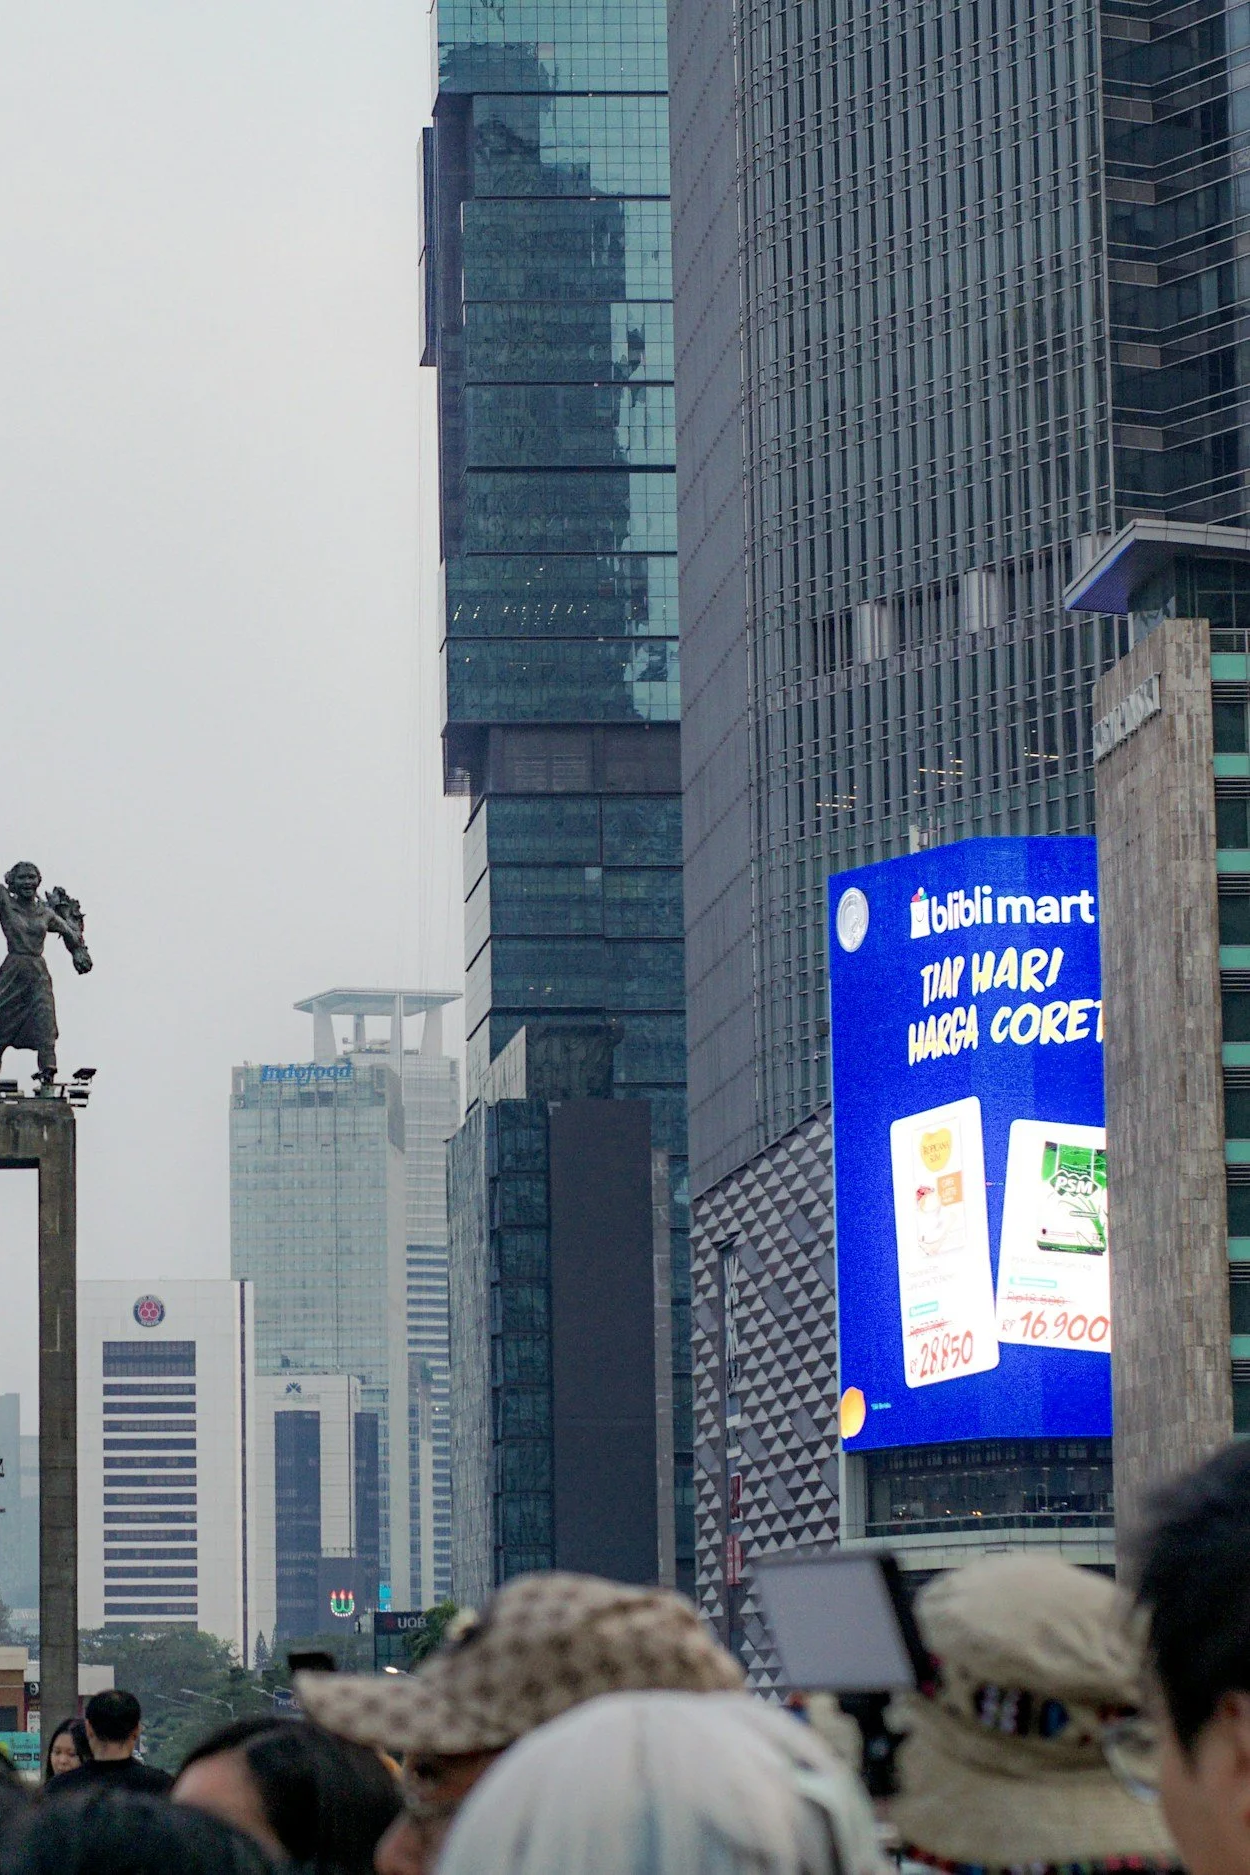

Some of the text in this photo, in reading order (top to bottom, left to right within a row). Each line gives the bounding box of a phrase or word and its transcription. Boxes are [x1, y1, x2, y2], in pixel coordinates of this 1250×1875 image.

[931, 885, 1095, 934] blibli mart
[920, 947, 1065, 1008] TIAP HARI
[908, 1003, 979, 1067] HARGA
[260, 1061, 354, 1086] Indofood
[1054, 1176, 1093, 1194] PSM
[1020, 1310, 1110, 1342] 16.900
[919, 1330, 973, 1378] 28.850
[397, 1617, 428, 1629] UOB
